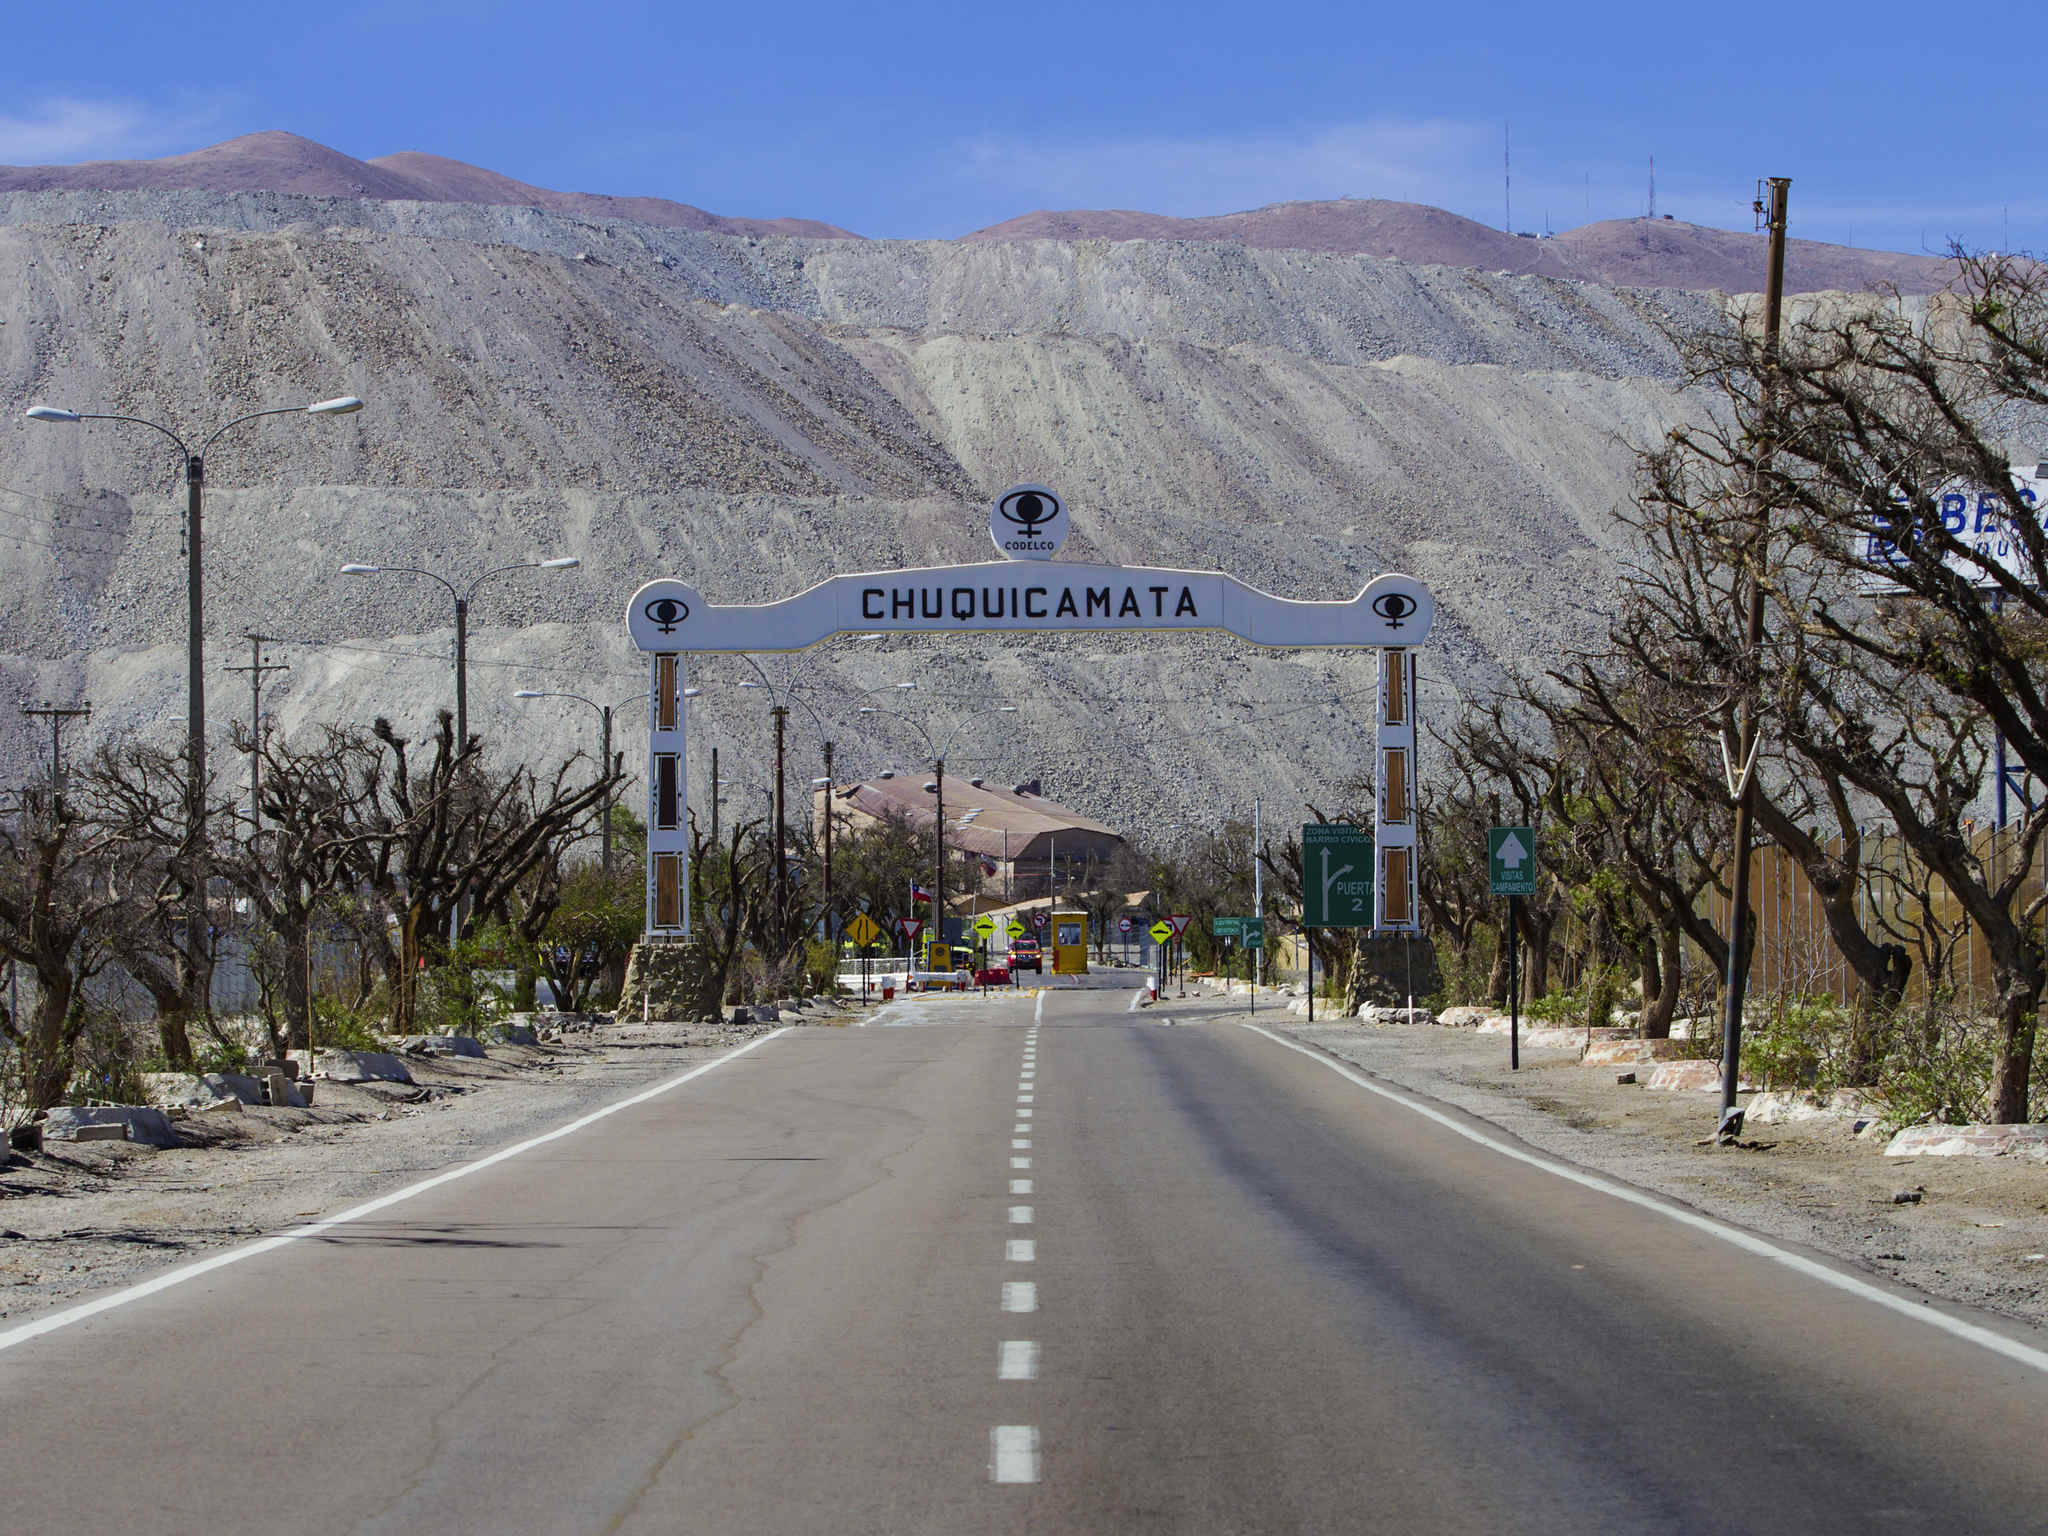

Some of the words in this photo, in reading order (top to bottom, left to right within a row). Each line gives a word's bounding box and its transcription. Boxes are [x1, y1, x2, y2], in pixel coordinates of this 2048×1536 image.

[1004, 541, 1054, 550] CODELCO
[862, 586, 1198, 621] CHUQUICAMATA
[1500, 871, 1524, 880] VISITAS
[1492, 881, 1533, 892] CAMPAMENTO
[1352, 898, 1362, 911] 2
